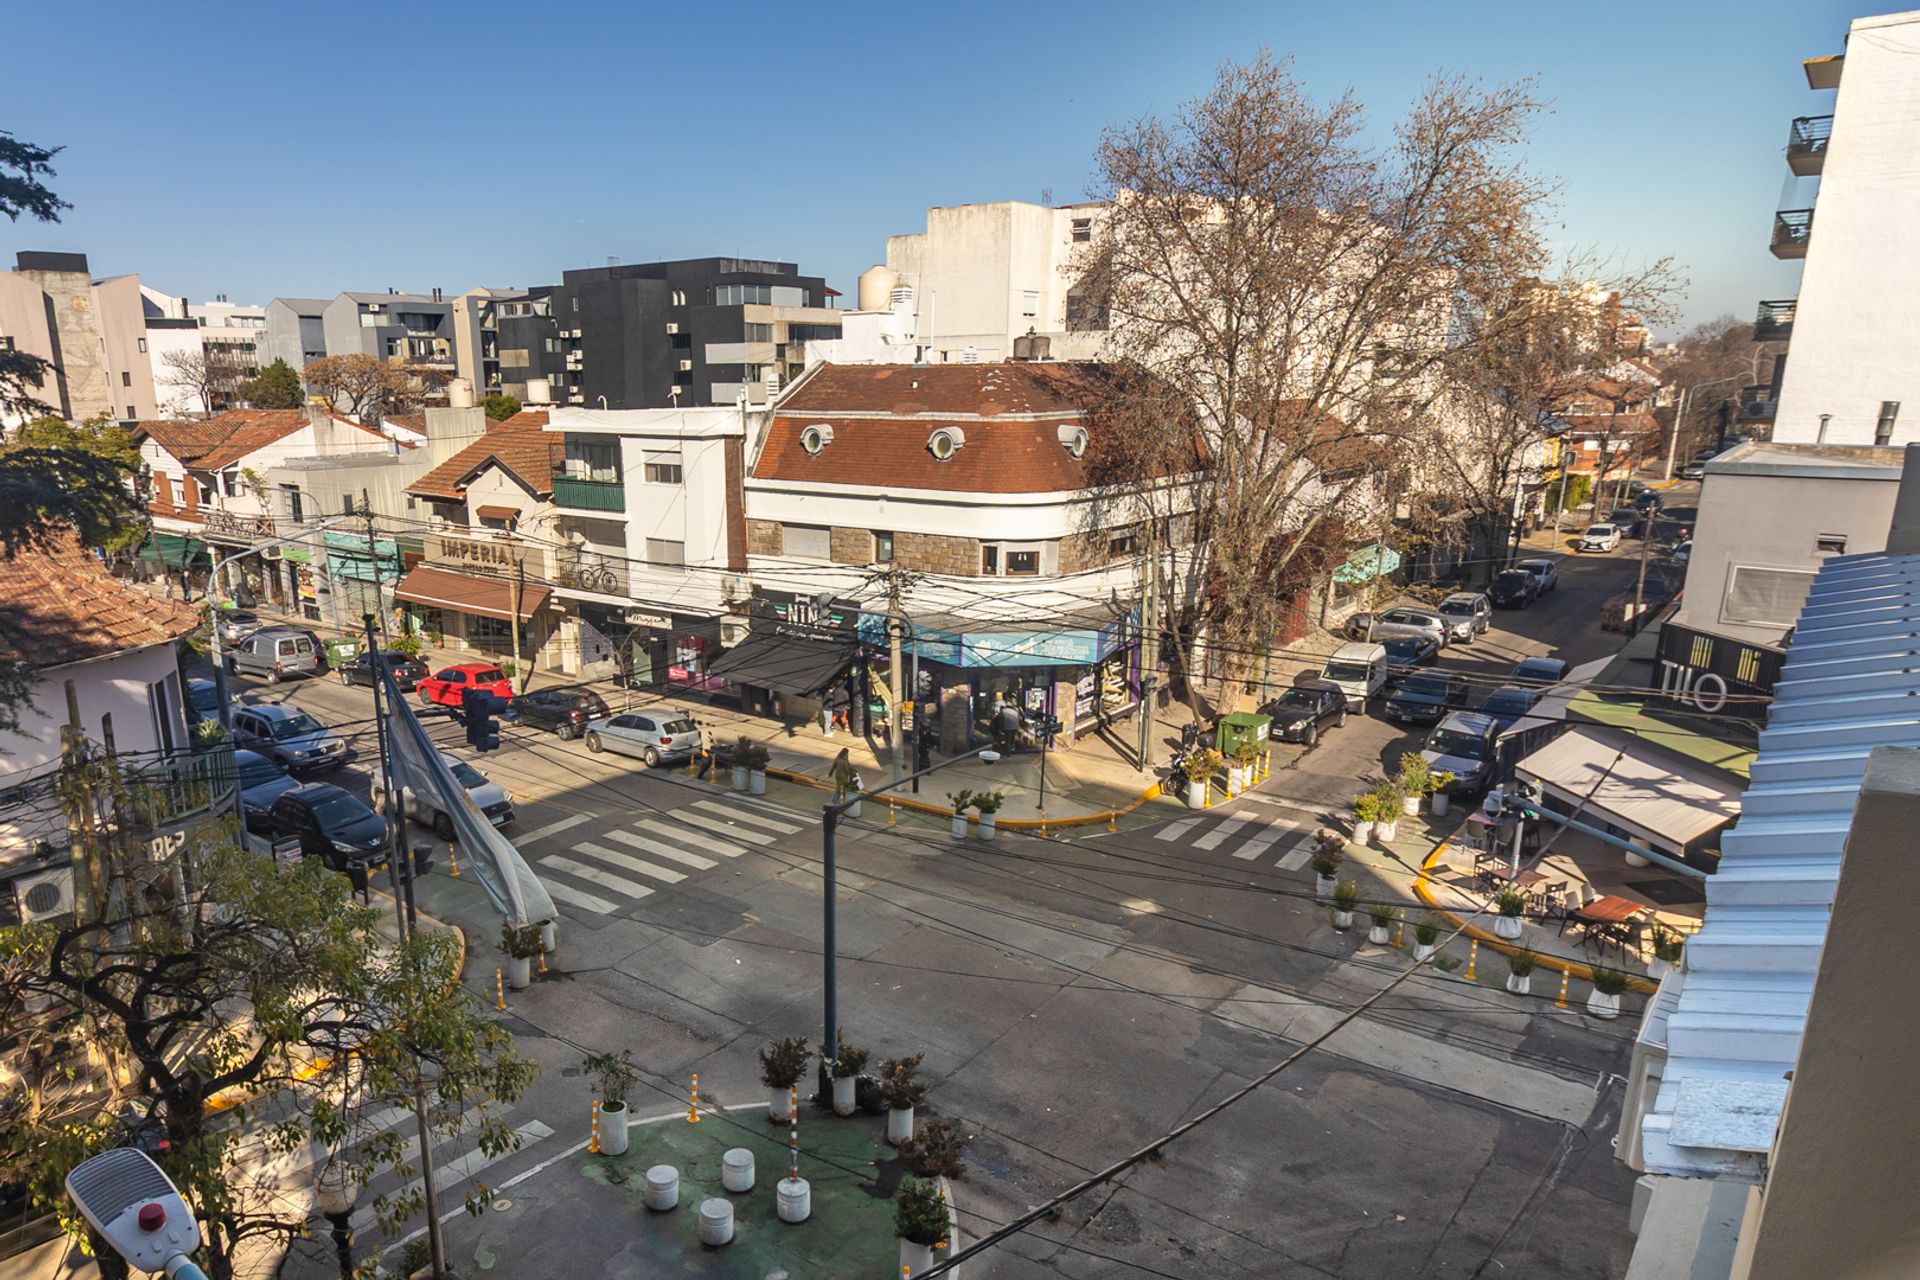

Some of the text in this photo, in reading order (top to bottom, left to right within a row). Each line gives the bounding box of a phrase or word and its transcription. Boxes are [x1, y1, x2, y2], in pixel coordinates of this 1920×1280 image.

[440, 539, 519, 567] IMPERIAL
[787, 603, 829, 631] NIN
[1661, 659, 1728, 713] TILO
